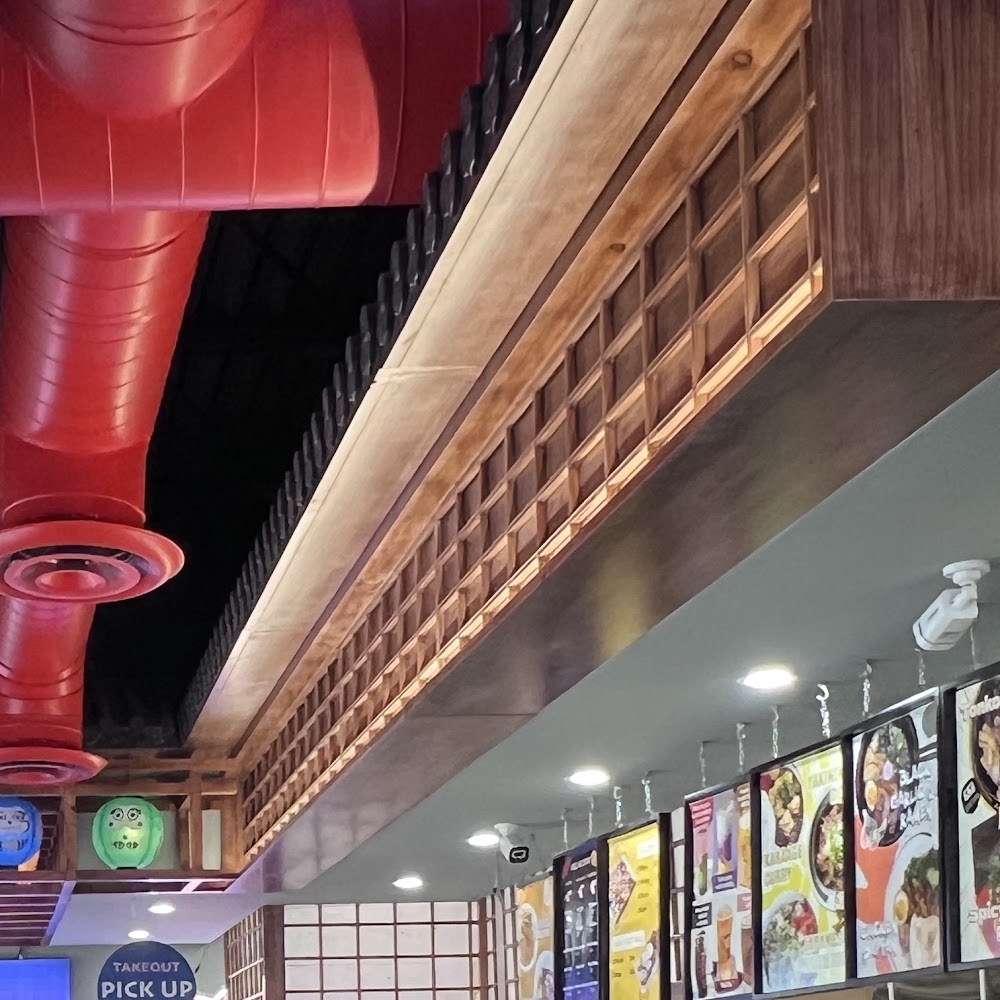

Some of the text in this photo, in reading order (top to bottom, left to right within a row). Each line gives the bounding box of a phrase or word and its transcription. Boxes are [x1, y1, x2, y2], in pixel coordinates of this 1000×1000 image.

[112, 961, 180, 972] TAKEOUT
[101, 980, 193, 998] PICK UP
